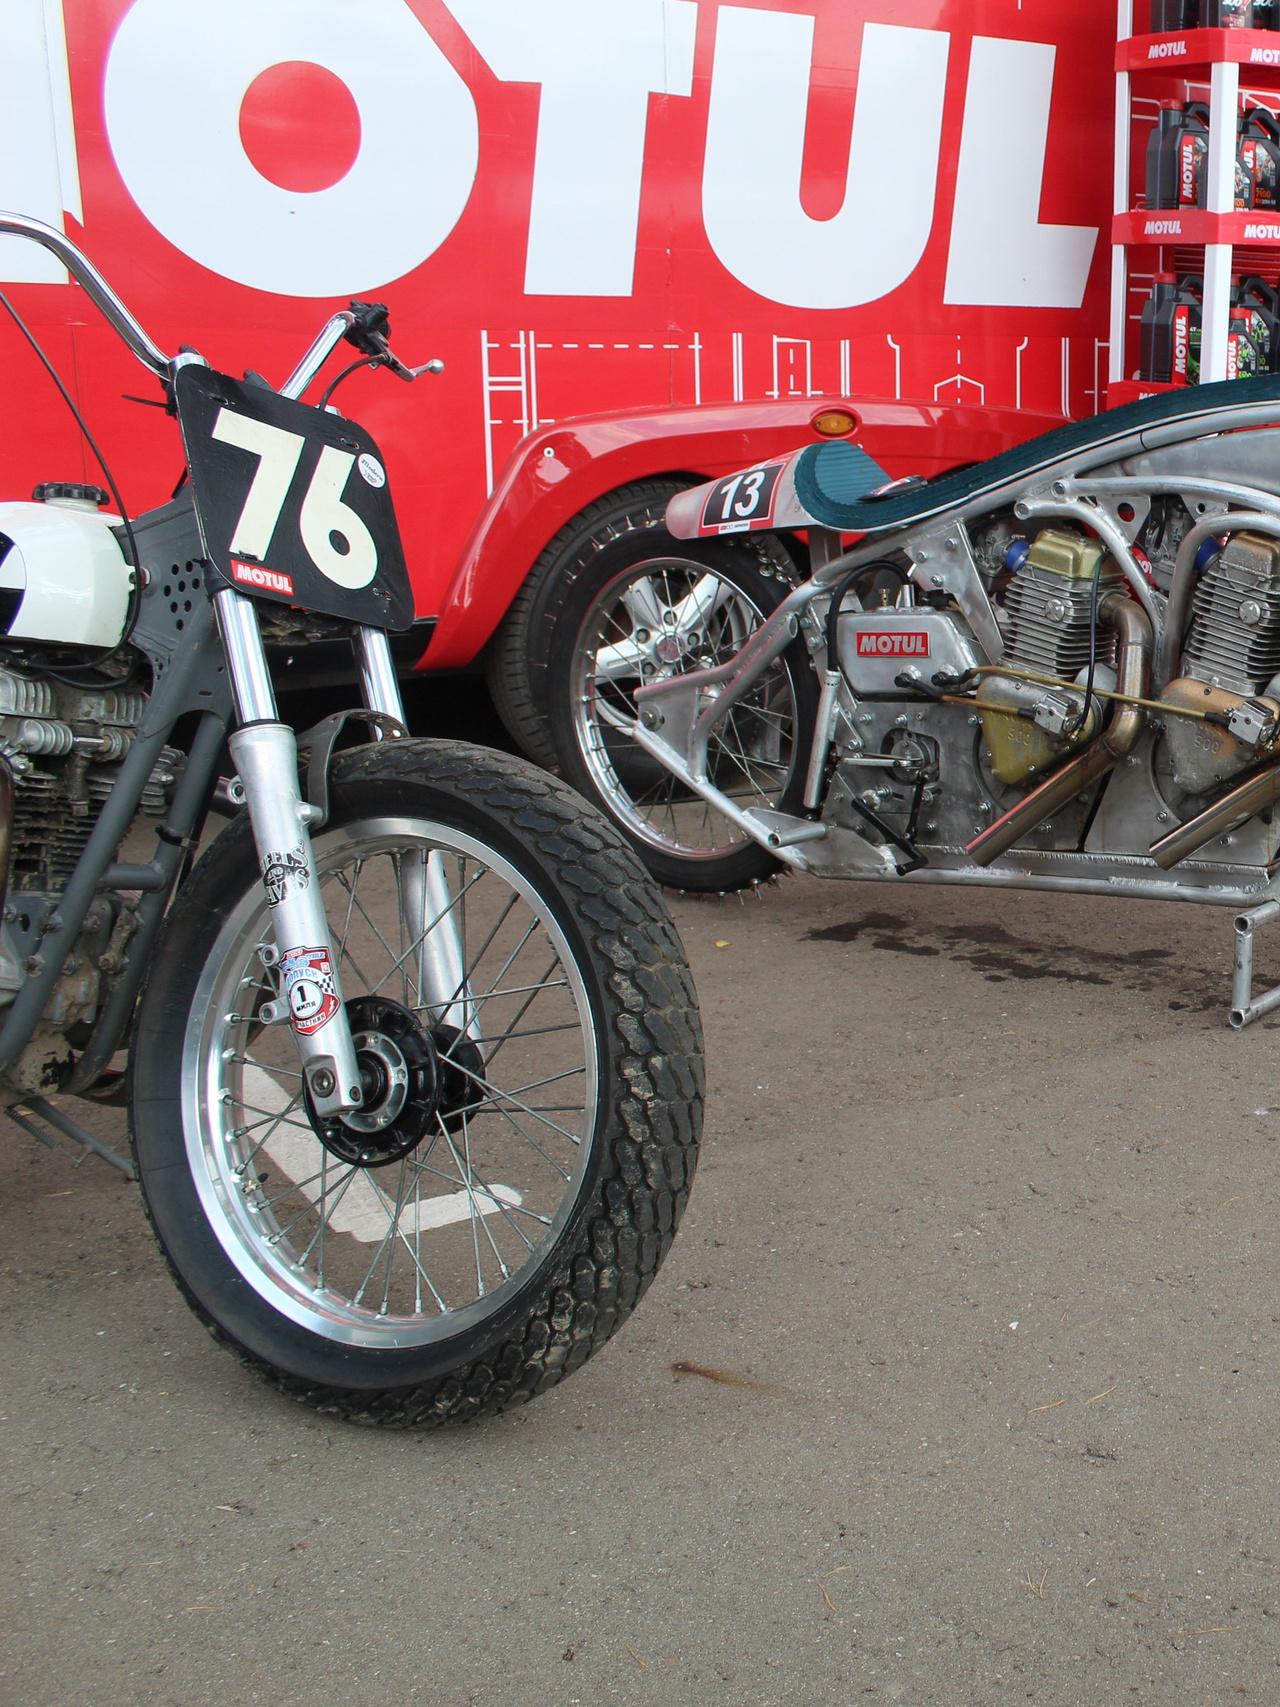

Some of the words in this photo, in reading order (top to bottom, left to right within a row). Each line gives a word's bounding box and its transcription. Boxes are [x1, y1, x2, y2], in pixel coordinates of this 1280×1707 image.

[1148, 41, 1187, 59] MOTUL
[1182, 144, 1193, 198] MOTUL
[1144, 221, 1182, 235] MOTUL
[1175, 316, 1187, 375] MOTUL
[211, 407, 378, 590] 76
[720, 471, 765, 519] 13
[236, 564, 293, 592] MOTUL
[860, 636, 926, 653] MOTUL
[297, 986, 307, 1002] 1
